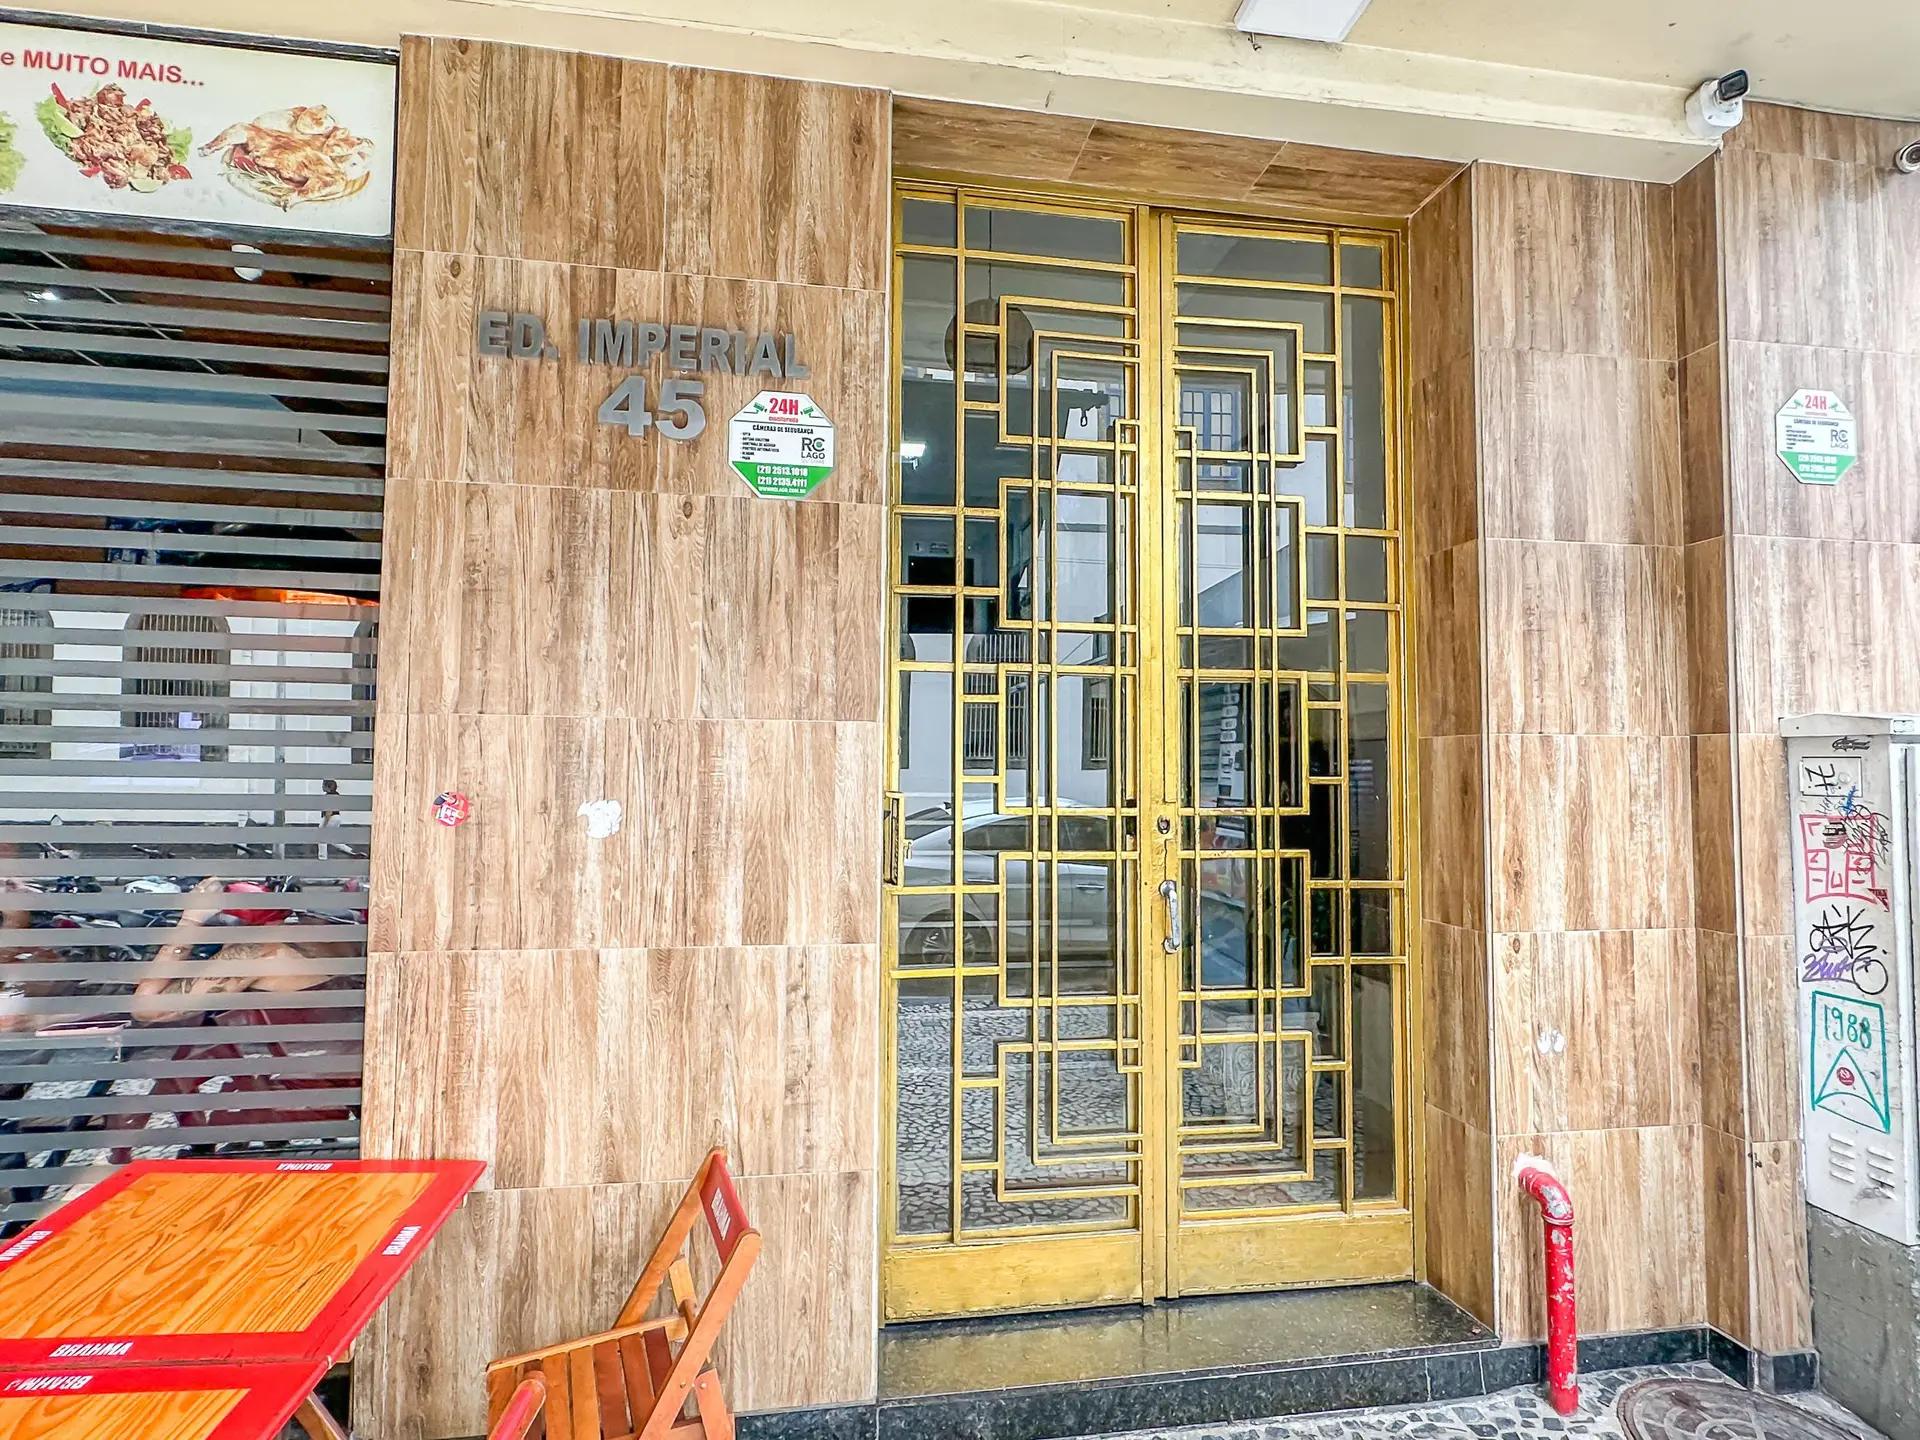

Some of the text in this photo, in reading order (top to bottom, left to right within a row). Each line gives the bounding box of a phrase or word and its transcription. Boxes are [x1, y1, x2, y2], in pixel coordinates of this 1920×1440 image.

[1, 49, 204, 86] e MUITO MAIS...
[478, 311, 810, 379] ED. IMPERIAL
[598, 375, 706, 441] 45
[769, 397, 799, 415] 24H
[1805, 394, 1827, 410] 24H
[752, 424, 776, 432] CÂMERAS
[1830, 429, 1848, 443] RC
[801, 437, 826, 452] RC
[801, 451, 826, 460] LAGO
[1824, 1004, 1872, 1049] 1988
[48, 1341, 134, 1357] BRAHMA
